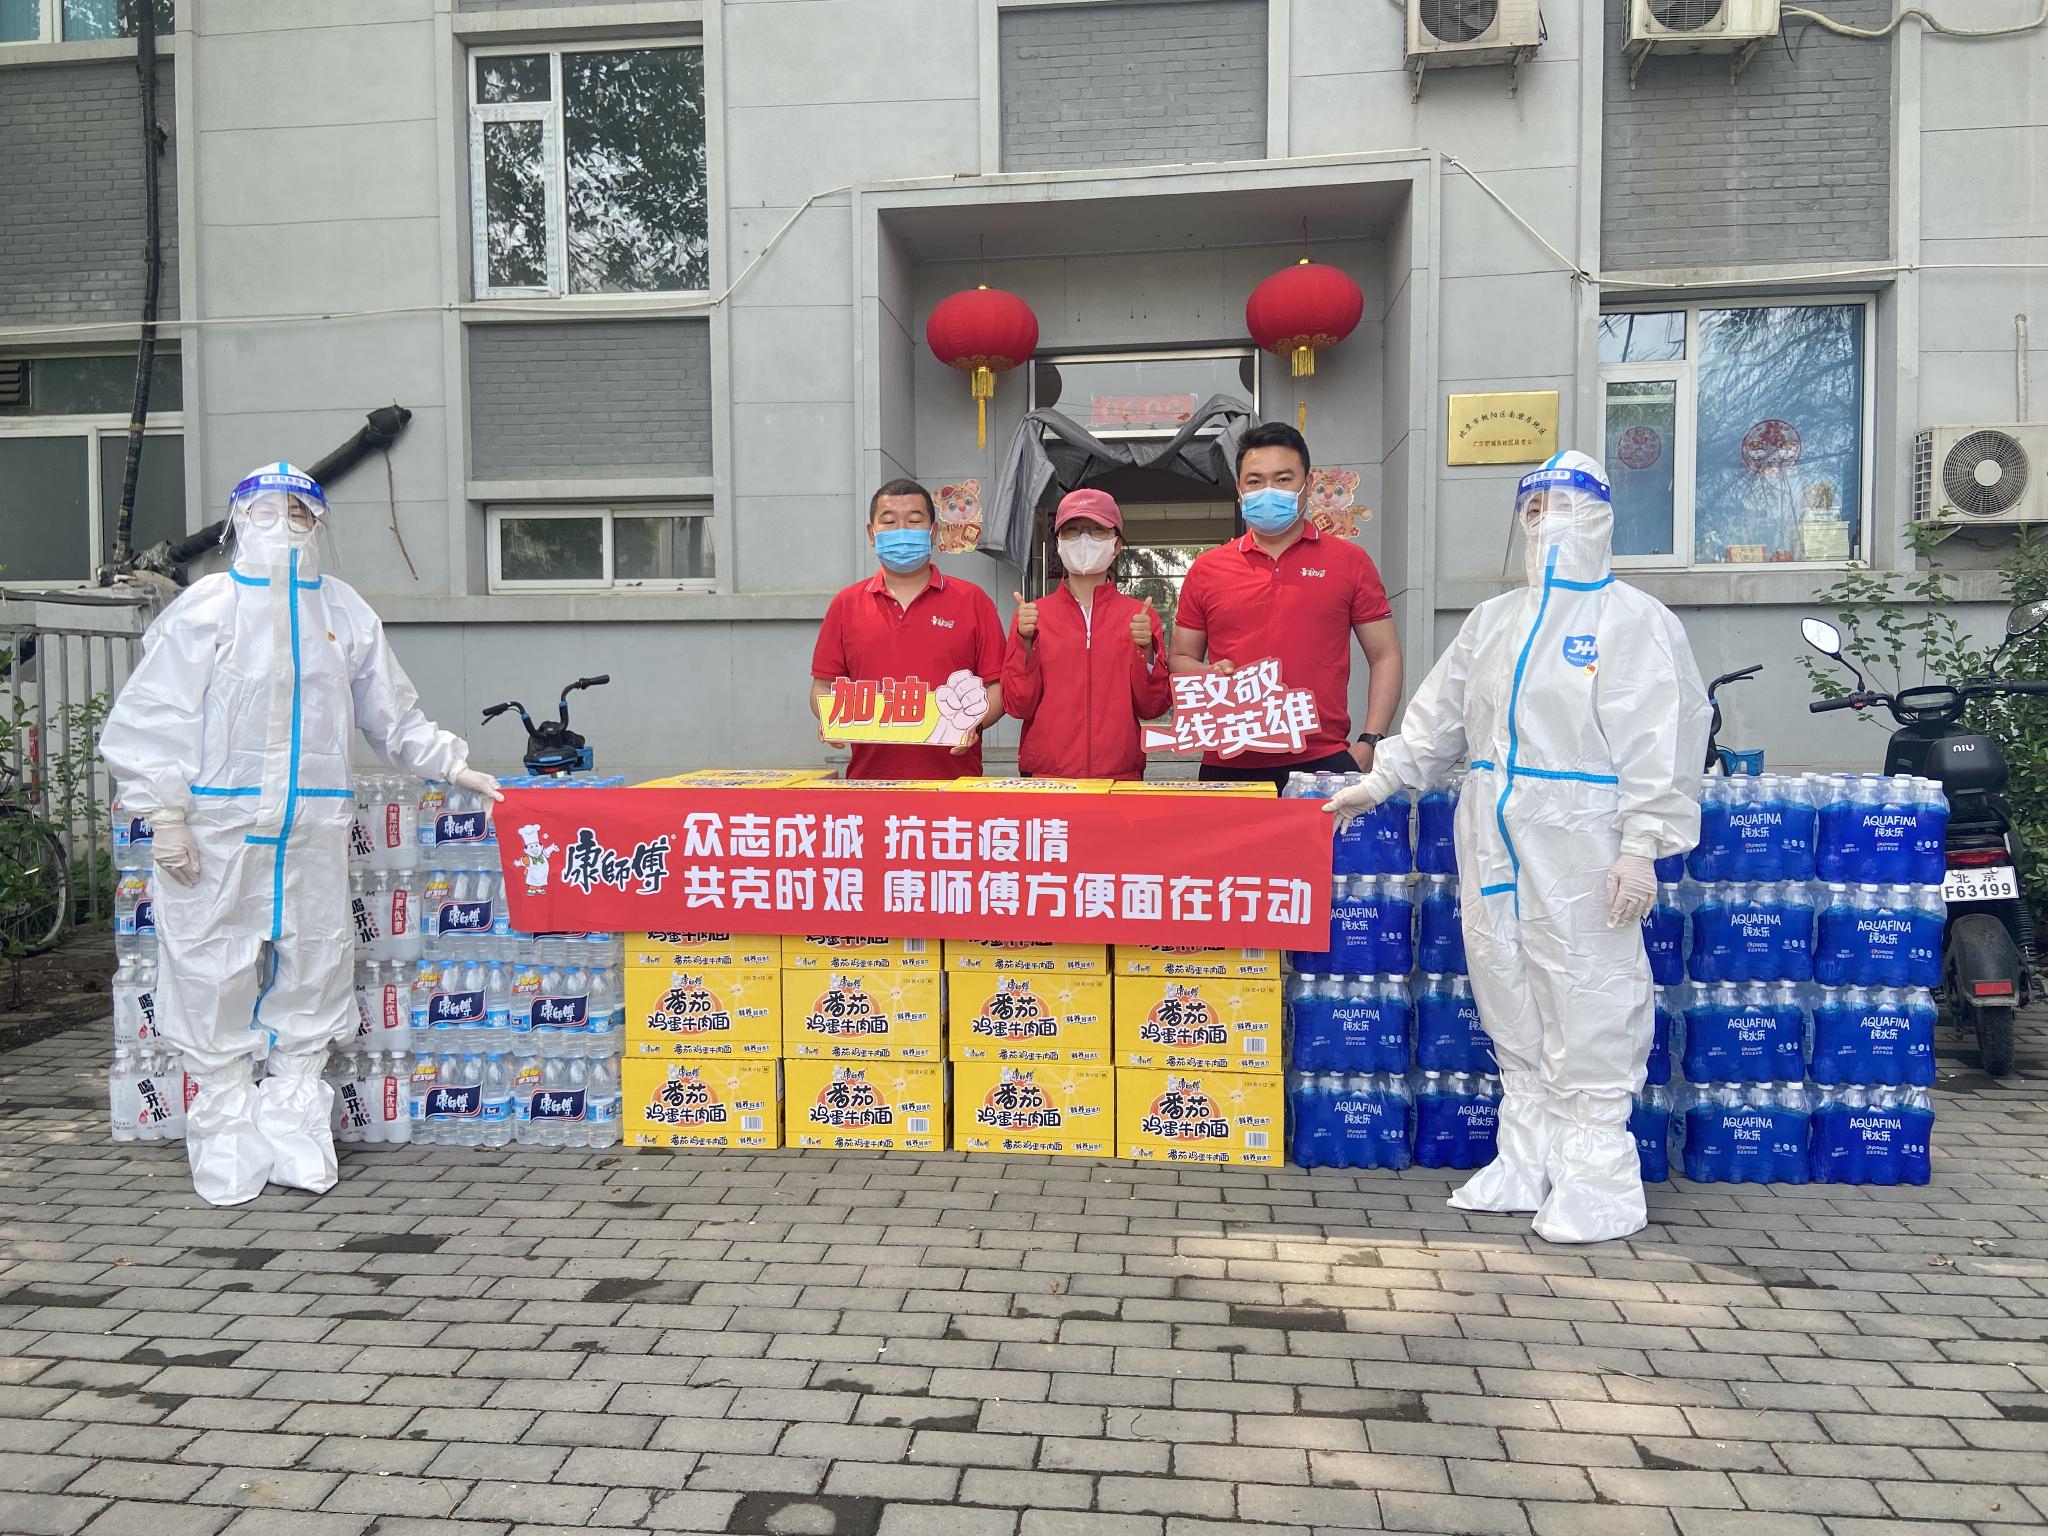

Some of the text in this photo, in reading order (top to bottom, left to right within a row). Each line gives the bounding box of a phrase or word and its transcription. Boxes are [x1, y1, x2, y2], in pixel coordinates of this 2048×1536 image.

[1314, 514, 1332, 529] 旺
[1172, 660, 1284, 710] 致敬
[829, 677, 928, 727] 加油
[1145, 691, 1319, 755] 一线英雄
[1729, 812, 1782, 828] AQUAFINA
[1862, 814, 1917, 828] AQUAFINA
[351, 818, 371, 856] 开水
[683, 811, 1069, 863] 众志成城 抗击疫情
[1741, 826, 1770, 838] 纯水乐
[1874, 827, 1904, 838] 纯水乐
[1956, 870, 1996, 884] 北京
[683, 866, 1312, 925] 共克时艰 康师傅方便面在行动
[1944, 882, 2012, 899] F63199
[351, 897, 376, 944] 喝开水
[1331, 907, 1379, 921] AQUAFINA
[1730, 913, 1782, 927] AQUAFINA
[1341, 920, 1369, 932] 纯水乐
[1742, 926, 1771, 937] 纯水乐
[1856, 919, 1912, 934] AQUAFINA
[1868, 932, 1898, 945] 纯水乐
[673, 954, 732, 965] 番茄鸡蛋牛肉面
[830, 957, 890, 968] 番茄鸡蛋牛肉面
[994, 959, 1055, 969] 番茄鸡蛋牛肉面
[1164, 963, 1227, 975] 番茄鸡蛋牛肉面
[664, 988, 711, 1015] 番茄
[822, 989, 870, 1016] 番茄
[989, 992, 1038, 1019] 番茄
[1157, 999, 1208, 1026] 番茄
[1332, 1008, 1380, 1022] AQUAFINA
[648, 1012, 730, 1031] 鸡蛋牛肉面
[806, 1014, 889, 1034] 鸡蛋牛肉面
[972, 1017, 1057, 1037] 鸡蛋牛肉面
[1342, 1020, 1370, 1032] 纯水乐
[1727, 1017, 1777, 1030] AQUAFINA
[1860, 1016, 1911, 1031] AQUAFINA
[1140, 1024, 1227, 1044] 鸡蛋牛肉面
[1738, 1029, 1766, 1041] 纯水乐
[1870, 1028, 1899, 1040] 纯水乐
[673, 1044, 732, 1055] 番茄鸡蛋牛肉面
[831, 1045, 891, 1057] 番茄鸡蛋牛肉面
[998, 1048, 1059, 1060] 番茄鸡蛋牛肉面
[1166, 1055, 1228, 1067] 番茄鸡蛋牛肉面
[137, 1078, 168, 1123] 喝开水
[661, 1080, 708, 1107] 番茄
[826, 1081, 874, 1107] 番茄
[993, 1083, 1042, 1109] 番茄
[341, 1082, 368, 1127] 喝开水
[1158, 1091, 1209, 1118] 番茄
[1334, 1101, 1383, 1117] AQUAFINA
[1457, 1105, 1499, 1118] AQUAFIN
[645, 1104, 727, 1124] 鸡蛋牛肉面
[809, 1104, 893, 1126] 鸡蛋牛肉面
[976, 1107, 1061, 1128] 鸡蛋牛肉面
[1344, 1114, 1371, 1125] 纯水乐
[1142, 1117, 1229, 1138] 鸡蛋牛肉面
[1467, 1116, 1494, 1127] 纯水乐
[1722, 1116, 1773, 1130] AQUAFINA
[1849, 1117, 1902, 1131] AQUAFINA
[669, 1134, 728, 1146] 番茄鸡蛋牛肉面
[834, 1136, 894, 1148] 番茄鸡蛋牛肉面
[1733, 1129, 1761, 1142] 纯水乐
[1862, 1129, 1891, 1142] 纯水乐
[1002, 1138, 1063, 1151] 番茄鸡蛋牛肉面
[1167, 1150, 1230, 1162] 番茄鸡蛋牛肉面
